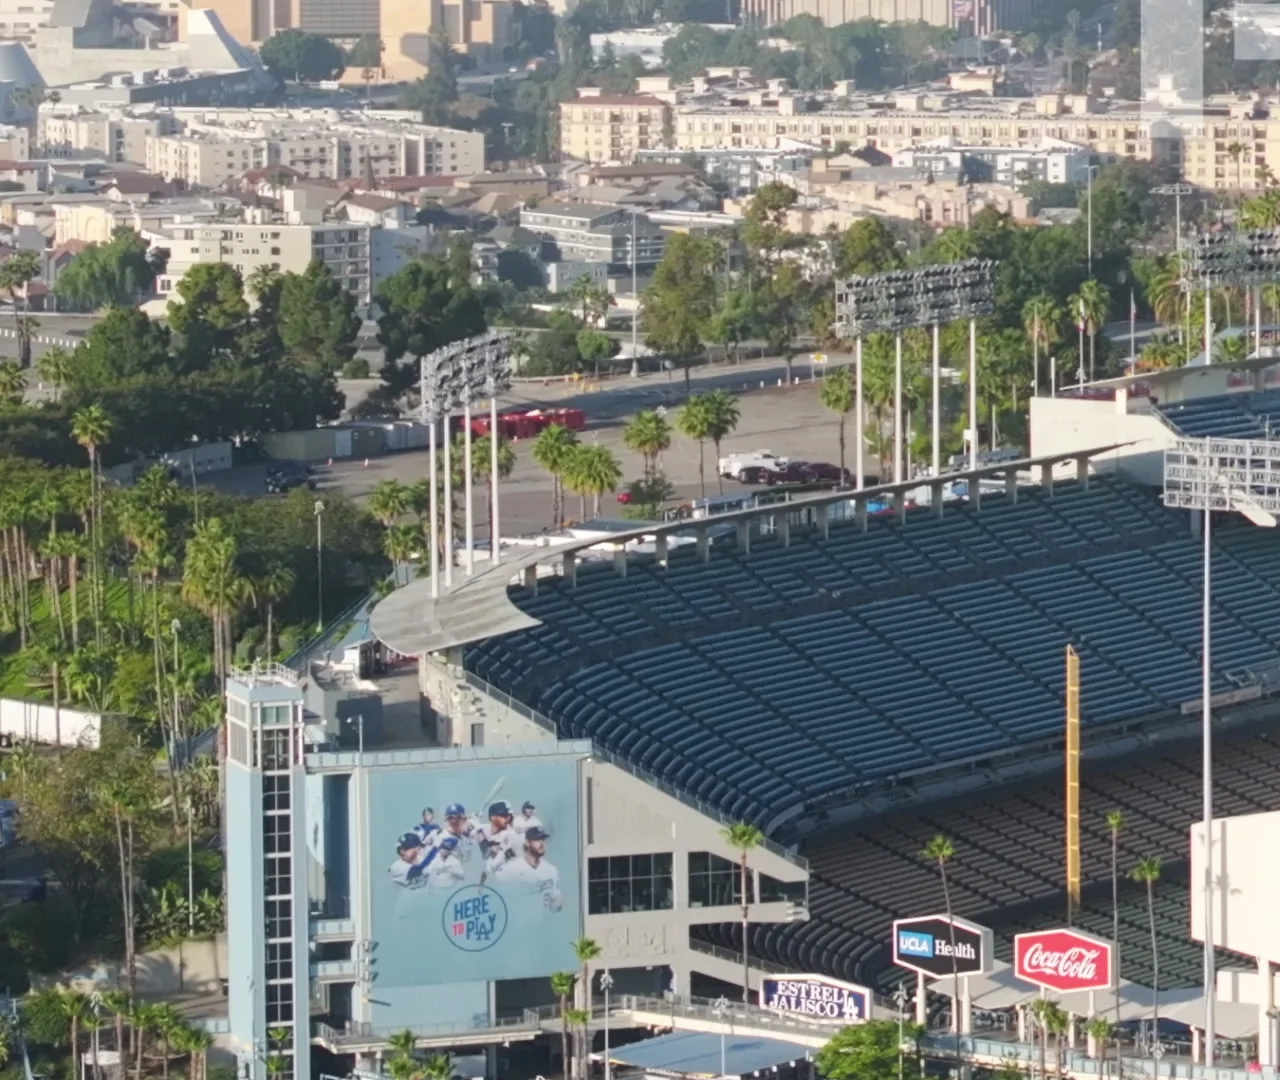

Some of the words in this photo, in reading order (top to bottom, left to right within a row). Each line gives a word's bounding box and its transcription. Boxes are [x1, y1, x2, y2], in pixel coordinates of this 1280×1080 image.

[453, 894, 490, 921] HERE
[452, 922, 465, 936] TO
[466, 913, 497, 941] PLAY
[900, 936, 929, 953] UCLA
[934, 939, 976, 960] Health
[769, 994, 839, 1018] JALISCO
